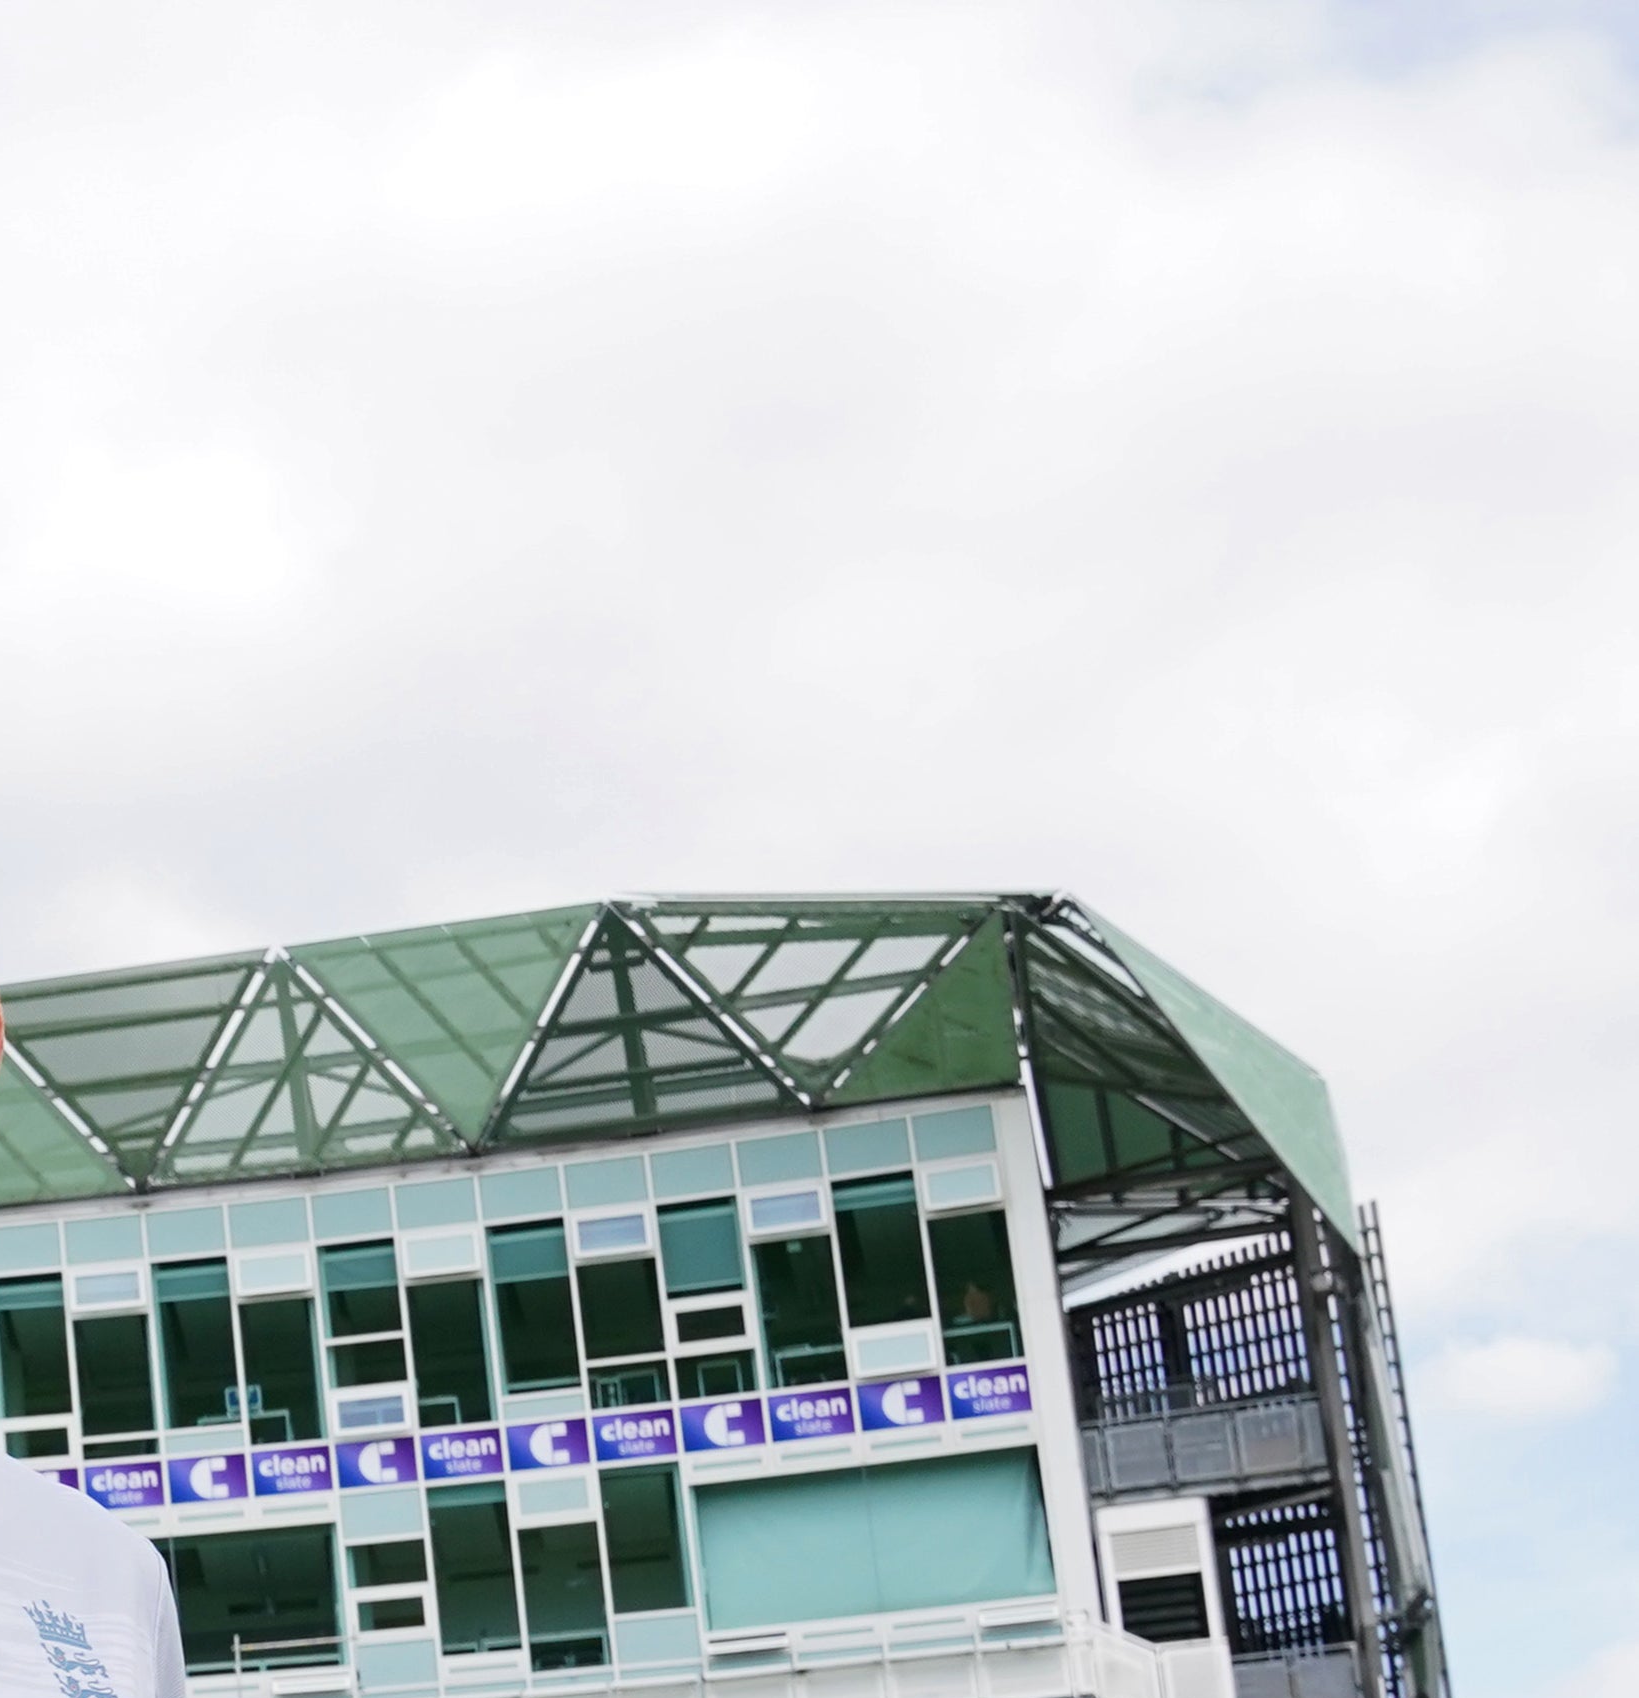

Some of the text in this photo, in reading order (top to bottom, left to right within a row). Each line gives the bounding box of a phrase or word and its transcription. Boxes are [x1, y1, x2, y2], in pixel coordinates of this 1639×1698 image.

[953, 1371, 1028, 1399] clean
[775, 1395, 849, 1421] clean
[599, 1415, 672, 1442] clean
[427, 1435, 498, 1461] clean
[258, 1453, 328, 1478] clean
[91, 1468, 159, 1492] clean
